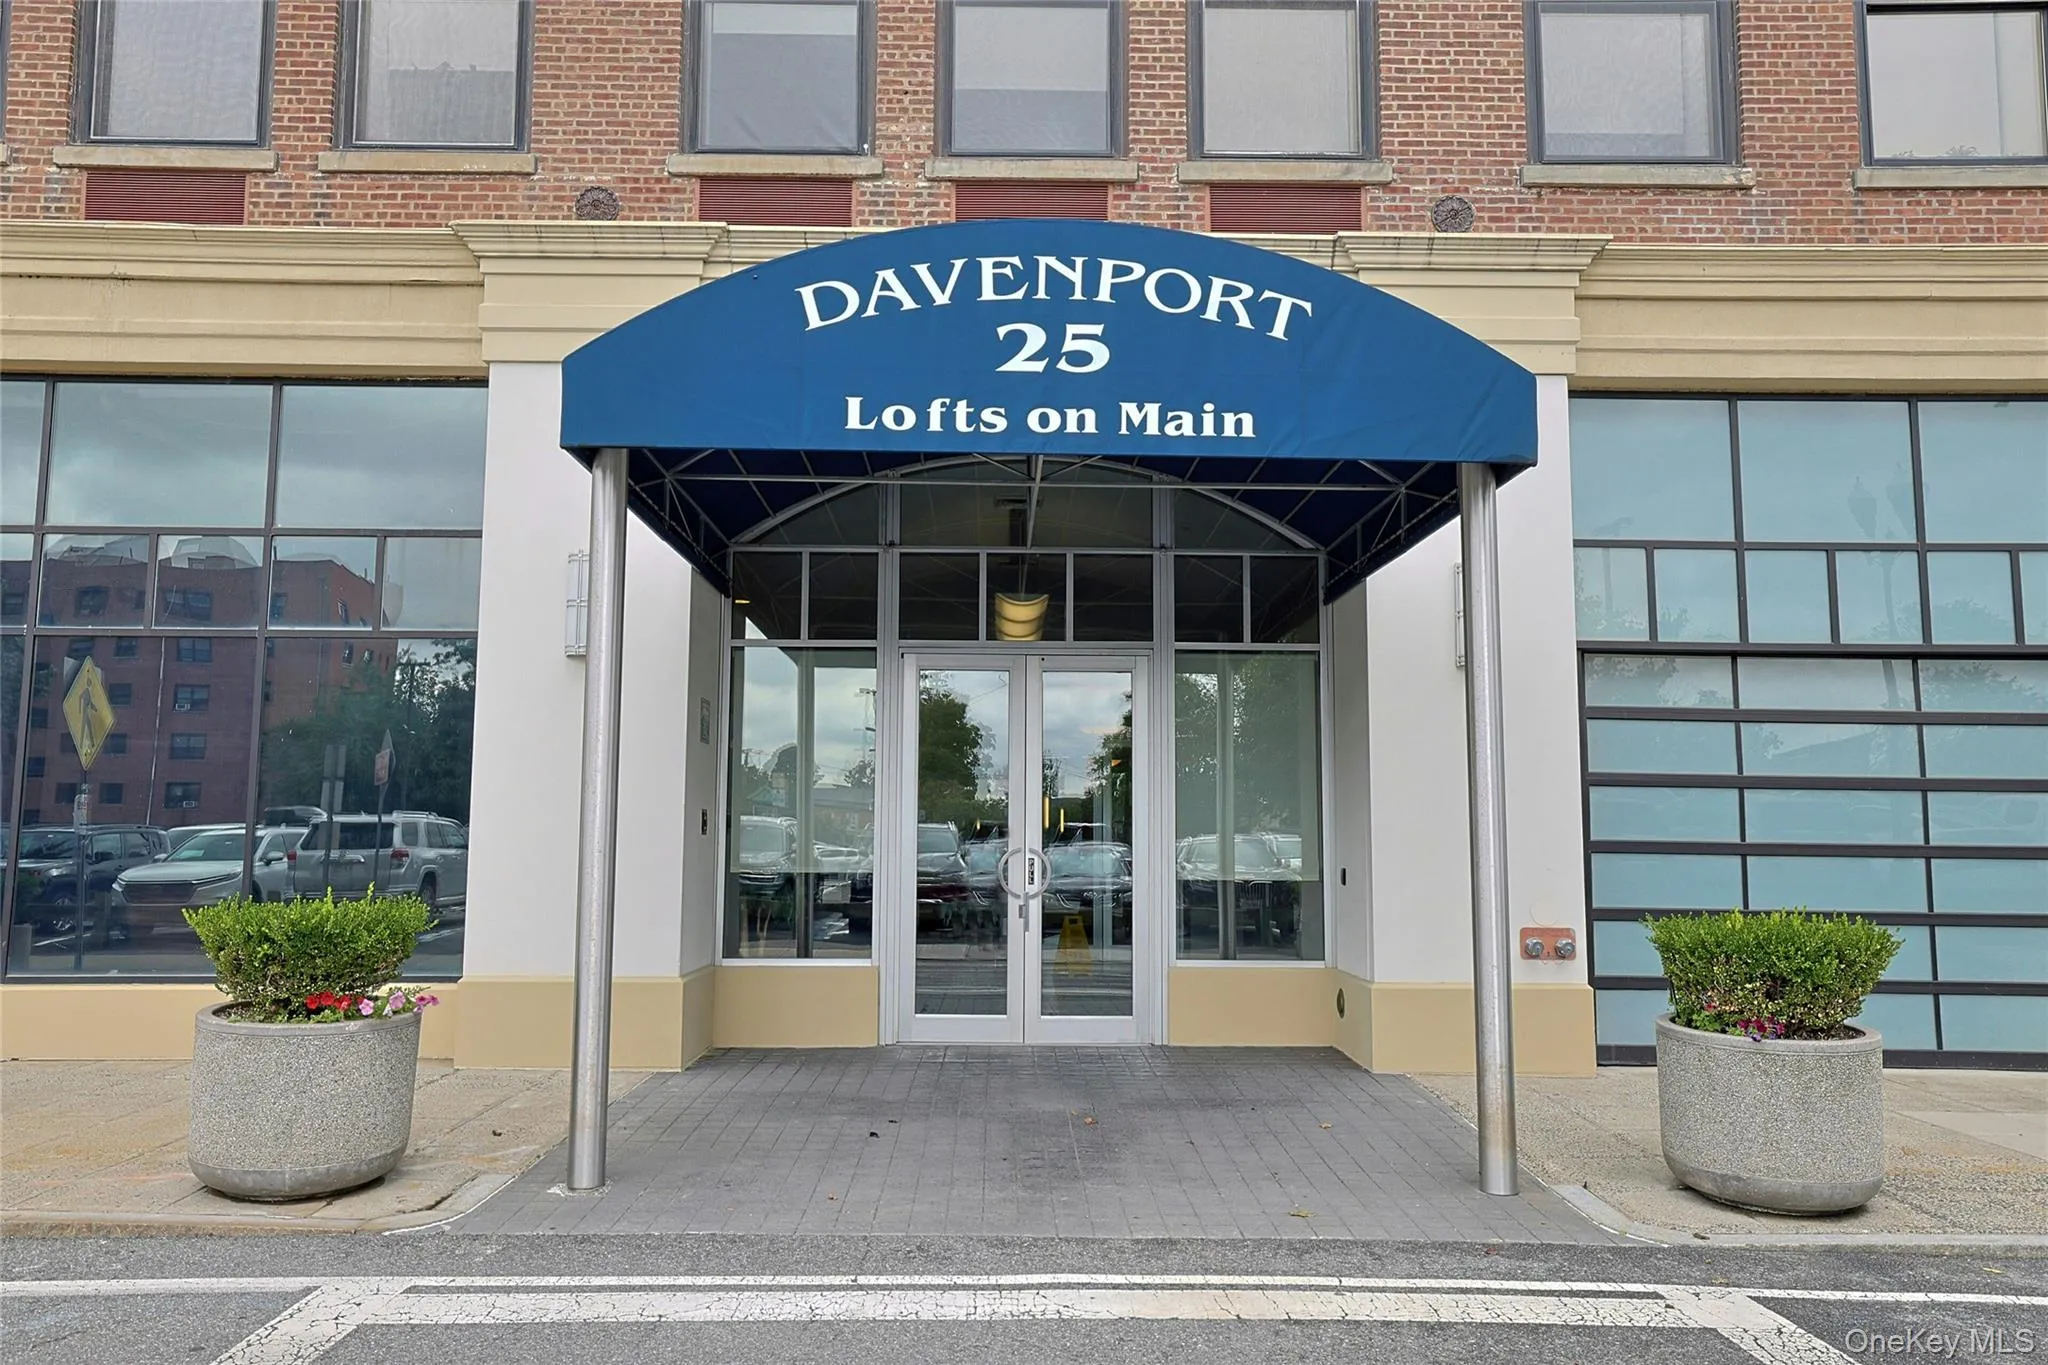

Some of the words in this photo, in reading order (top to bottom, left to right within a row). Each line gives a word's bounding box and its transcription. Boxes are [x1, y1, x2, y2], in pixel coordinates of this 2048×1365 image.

[795, 255, 1312, 341] DAVENPORT
[995, 323, 1110, 373] 25
[844, 396, 1008, 433] Lofts
[1027, 407, 1098, 434] on
[1118, 402, 1256, 438] Main
